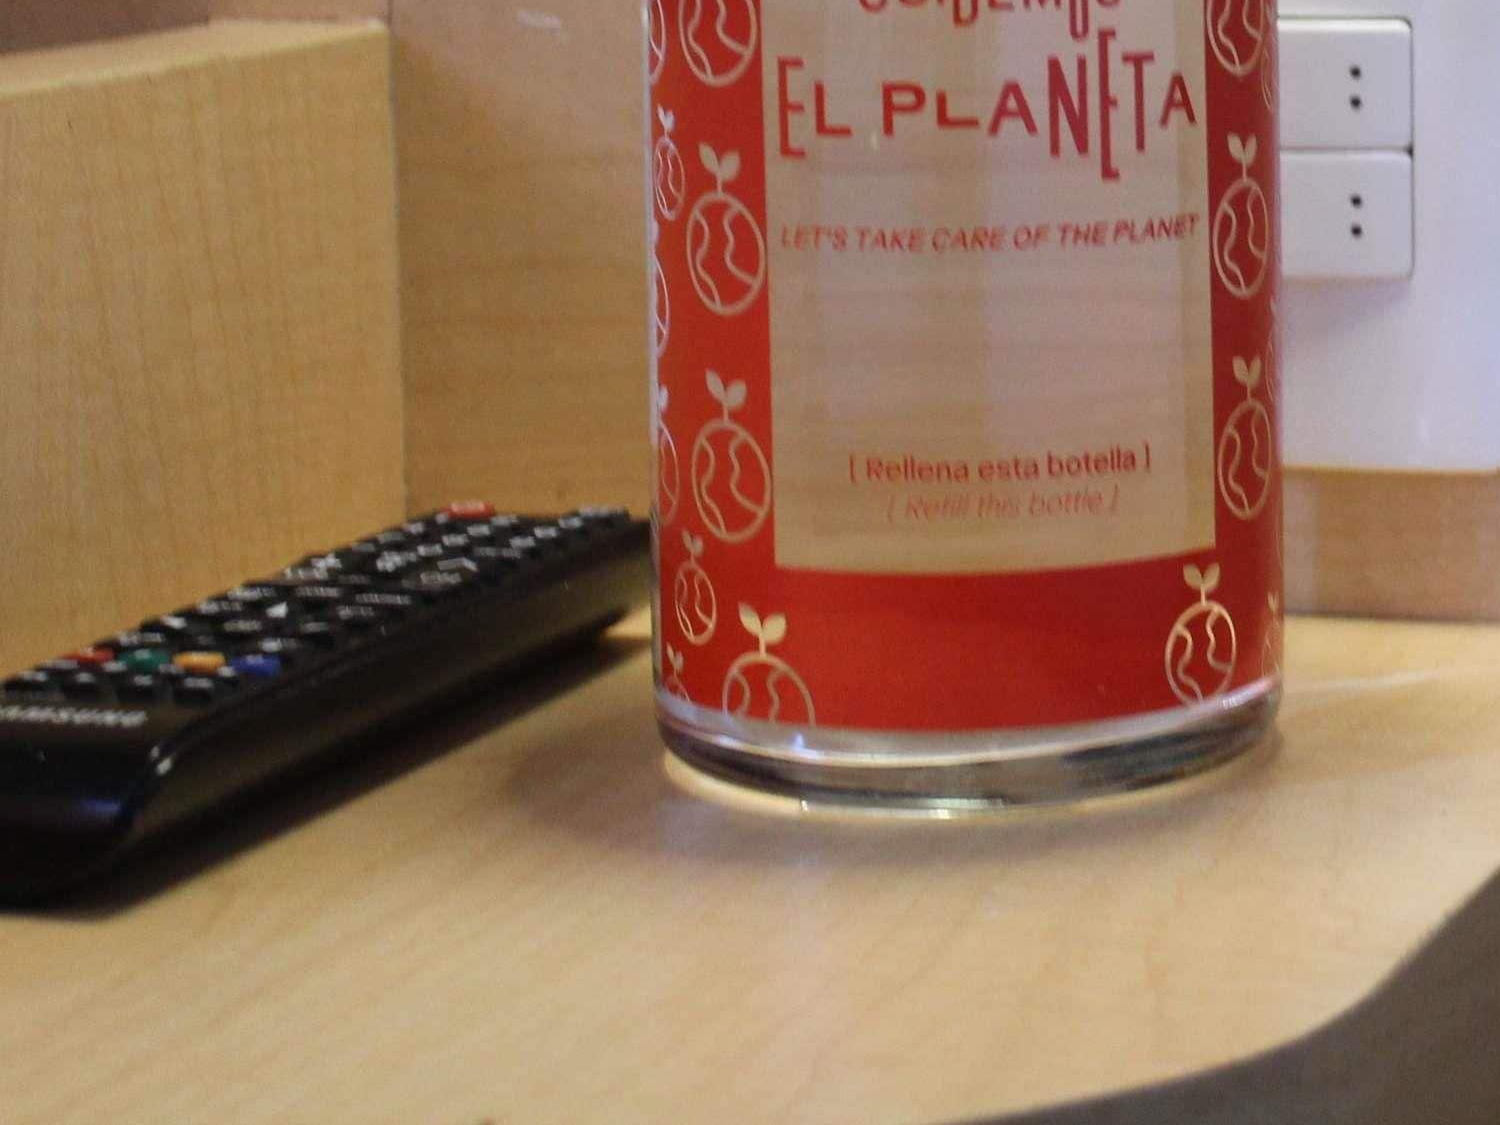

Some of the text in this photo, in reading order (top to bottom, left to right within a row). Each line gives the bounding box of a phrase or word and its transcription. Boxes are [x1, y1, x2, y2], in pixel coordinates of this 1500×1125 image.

[777, 26, 1198, 181] EL PLANETA
[780, 211, 1200, 254] LET'S TAKE CARE OF THE PLANET
[866, 454, 969, 483] Rellena
[977, 456, 1040, 482] esta
[1046, 444, 1137, 479] botella
